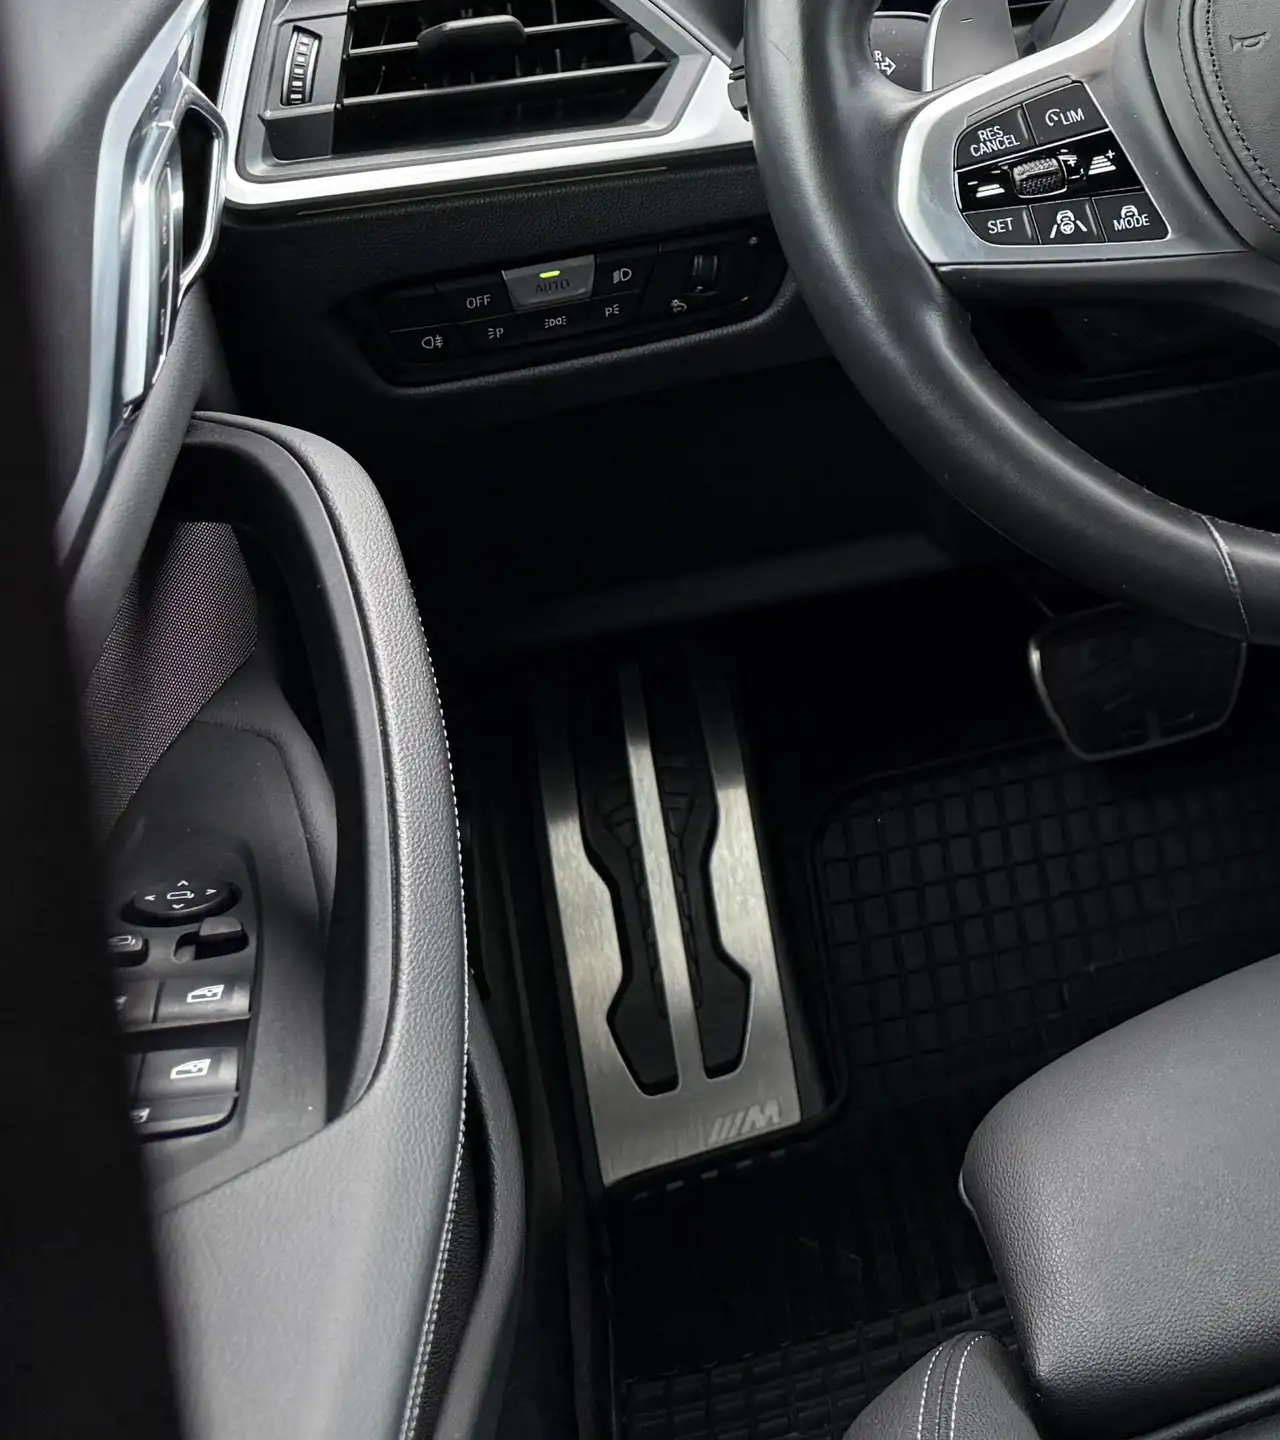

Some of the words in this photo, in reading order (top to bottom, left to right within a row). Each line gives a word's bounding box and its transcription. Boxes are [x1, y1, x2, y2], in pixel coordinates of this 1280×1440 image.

[1061, 108, 1085, 125] LIM
[977, 125, 1004, 142] RES
[970, 135, 1020, 157] CANCEL
[987, 217, 1014, 235] SET
[1113, 214, 1150, 232] MODE
[535, 279, 571, 295] AUTO
[466, 294, 491, 310] OFF
